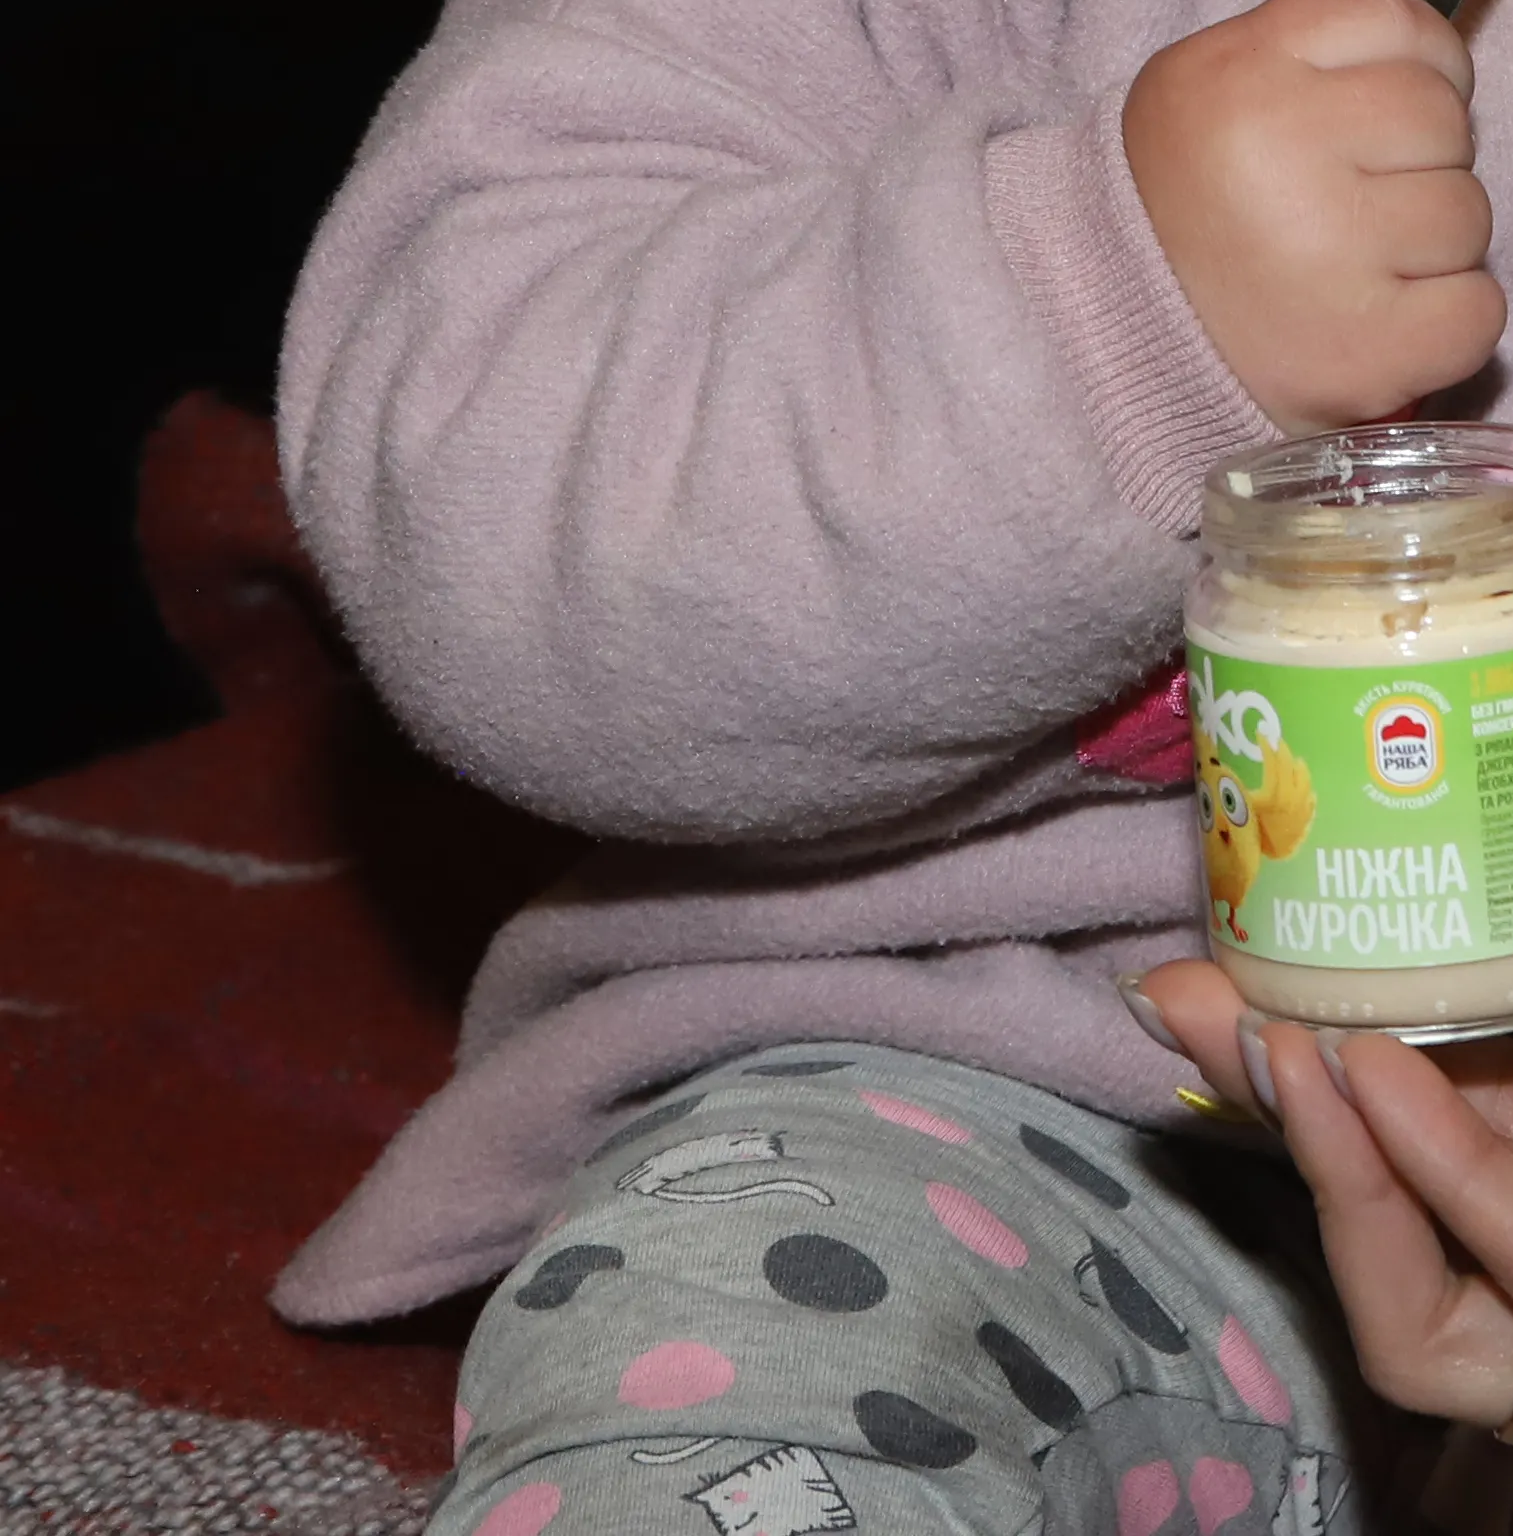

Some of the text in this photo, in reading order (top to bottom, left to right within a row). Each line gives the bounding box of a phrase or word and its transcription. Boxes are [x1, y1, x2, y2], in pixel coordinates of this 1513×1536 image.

[1382, 743, 1428, 757] НАША
[1383, 755, 1429, 771] РЯБА
[1315, 841, 1469, 901] НІЖНА
[1272, 896, 1473, 955] КУРОЧКА
